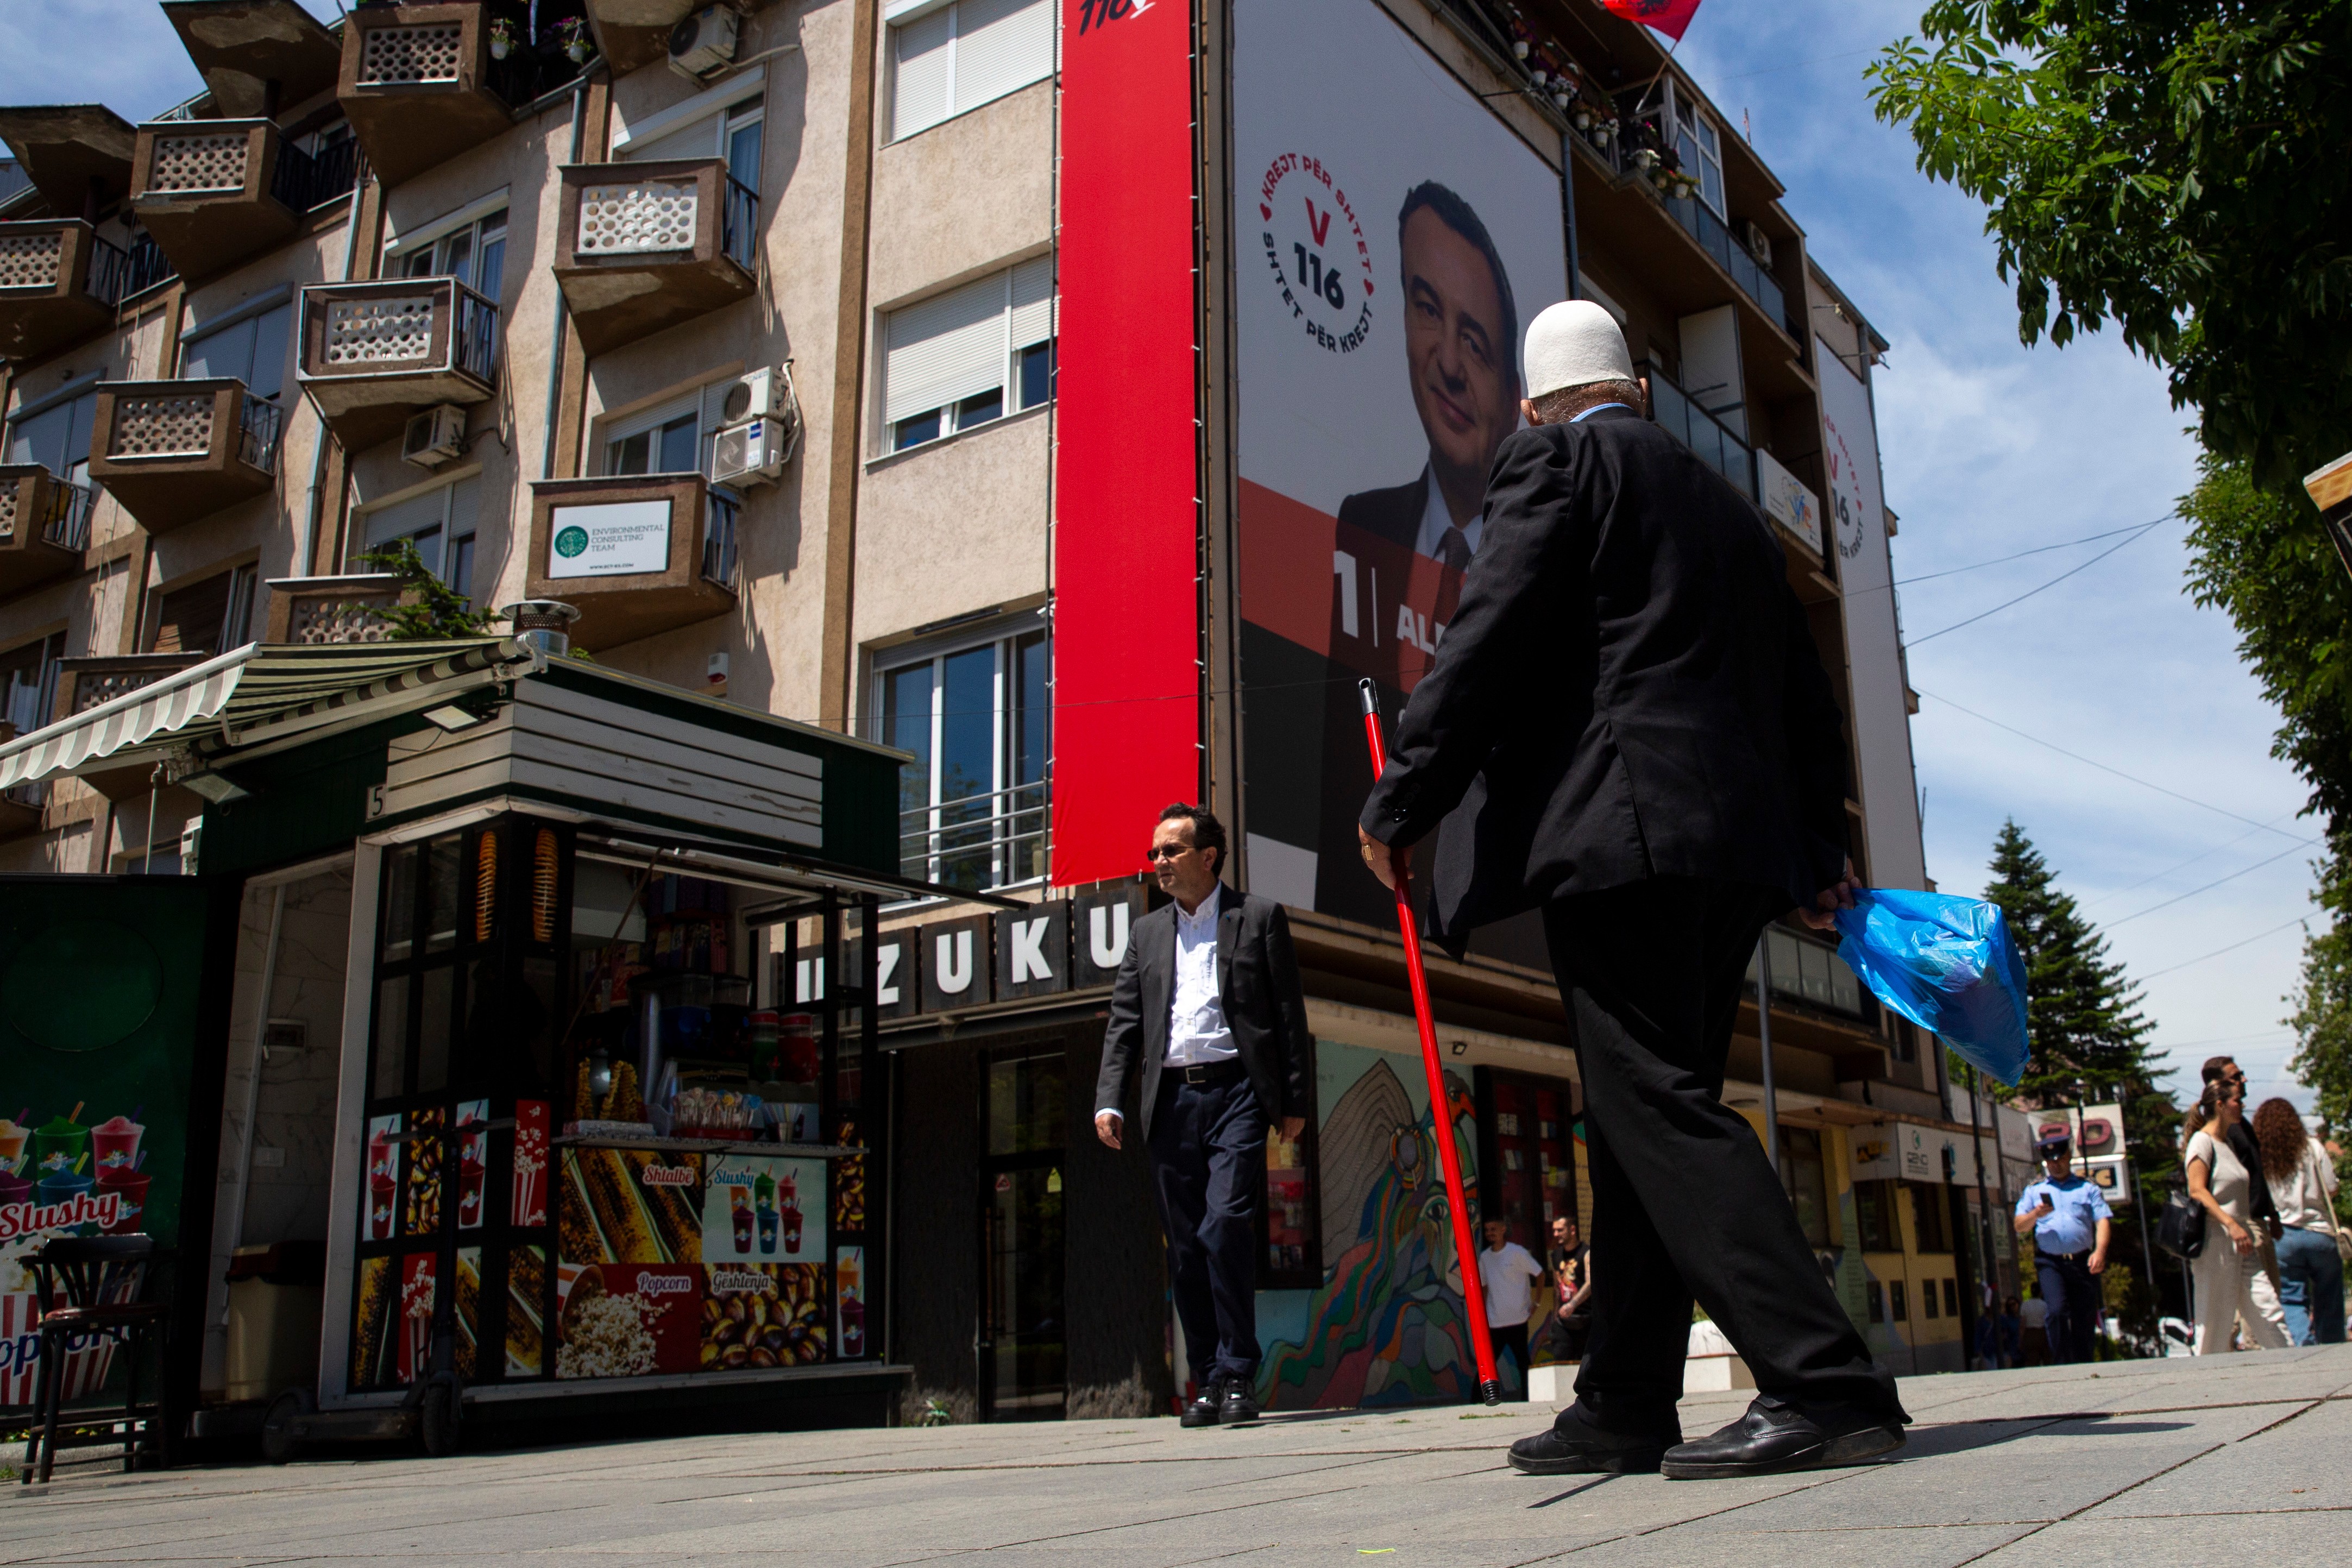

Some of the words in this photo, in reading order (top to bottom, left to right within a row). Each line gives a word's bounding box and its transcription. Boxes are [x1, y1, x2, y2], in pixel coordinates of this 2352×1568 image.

[1262, 153, 1298, 202] KREJT
[1303, 154, 1332, 190] PËR
[1335, 189, 1373, 274] SHTET
[1305, 196, 1331, 248] V
[1262, 231, 1304, 319] SHTET
[1306, 319, 1337, 352] PËR
[1339, 301, 1373, 353] KREJT
[1294, 241, 1345, 310] 116
[592, 534, 644, 544] CONSULTING
[592, 544, 615, 552] TEAM
[593, 524, 665, 536] ENVIRONMENTAL
[1333, 549, 1359, 639] 1
[370, 786, 384, 818] 5
[714, 1169, 754, 1189] Slushy
[0, 1194, 119, 1238] Slushy
[638, 1273, 690, 1296] Popcorn
